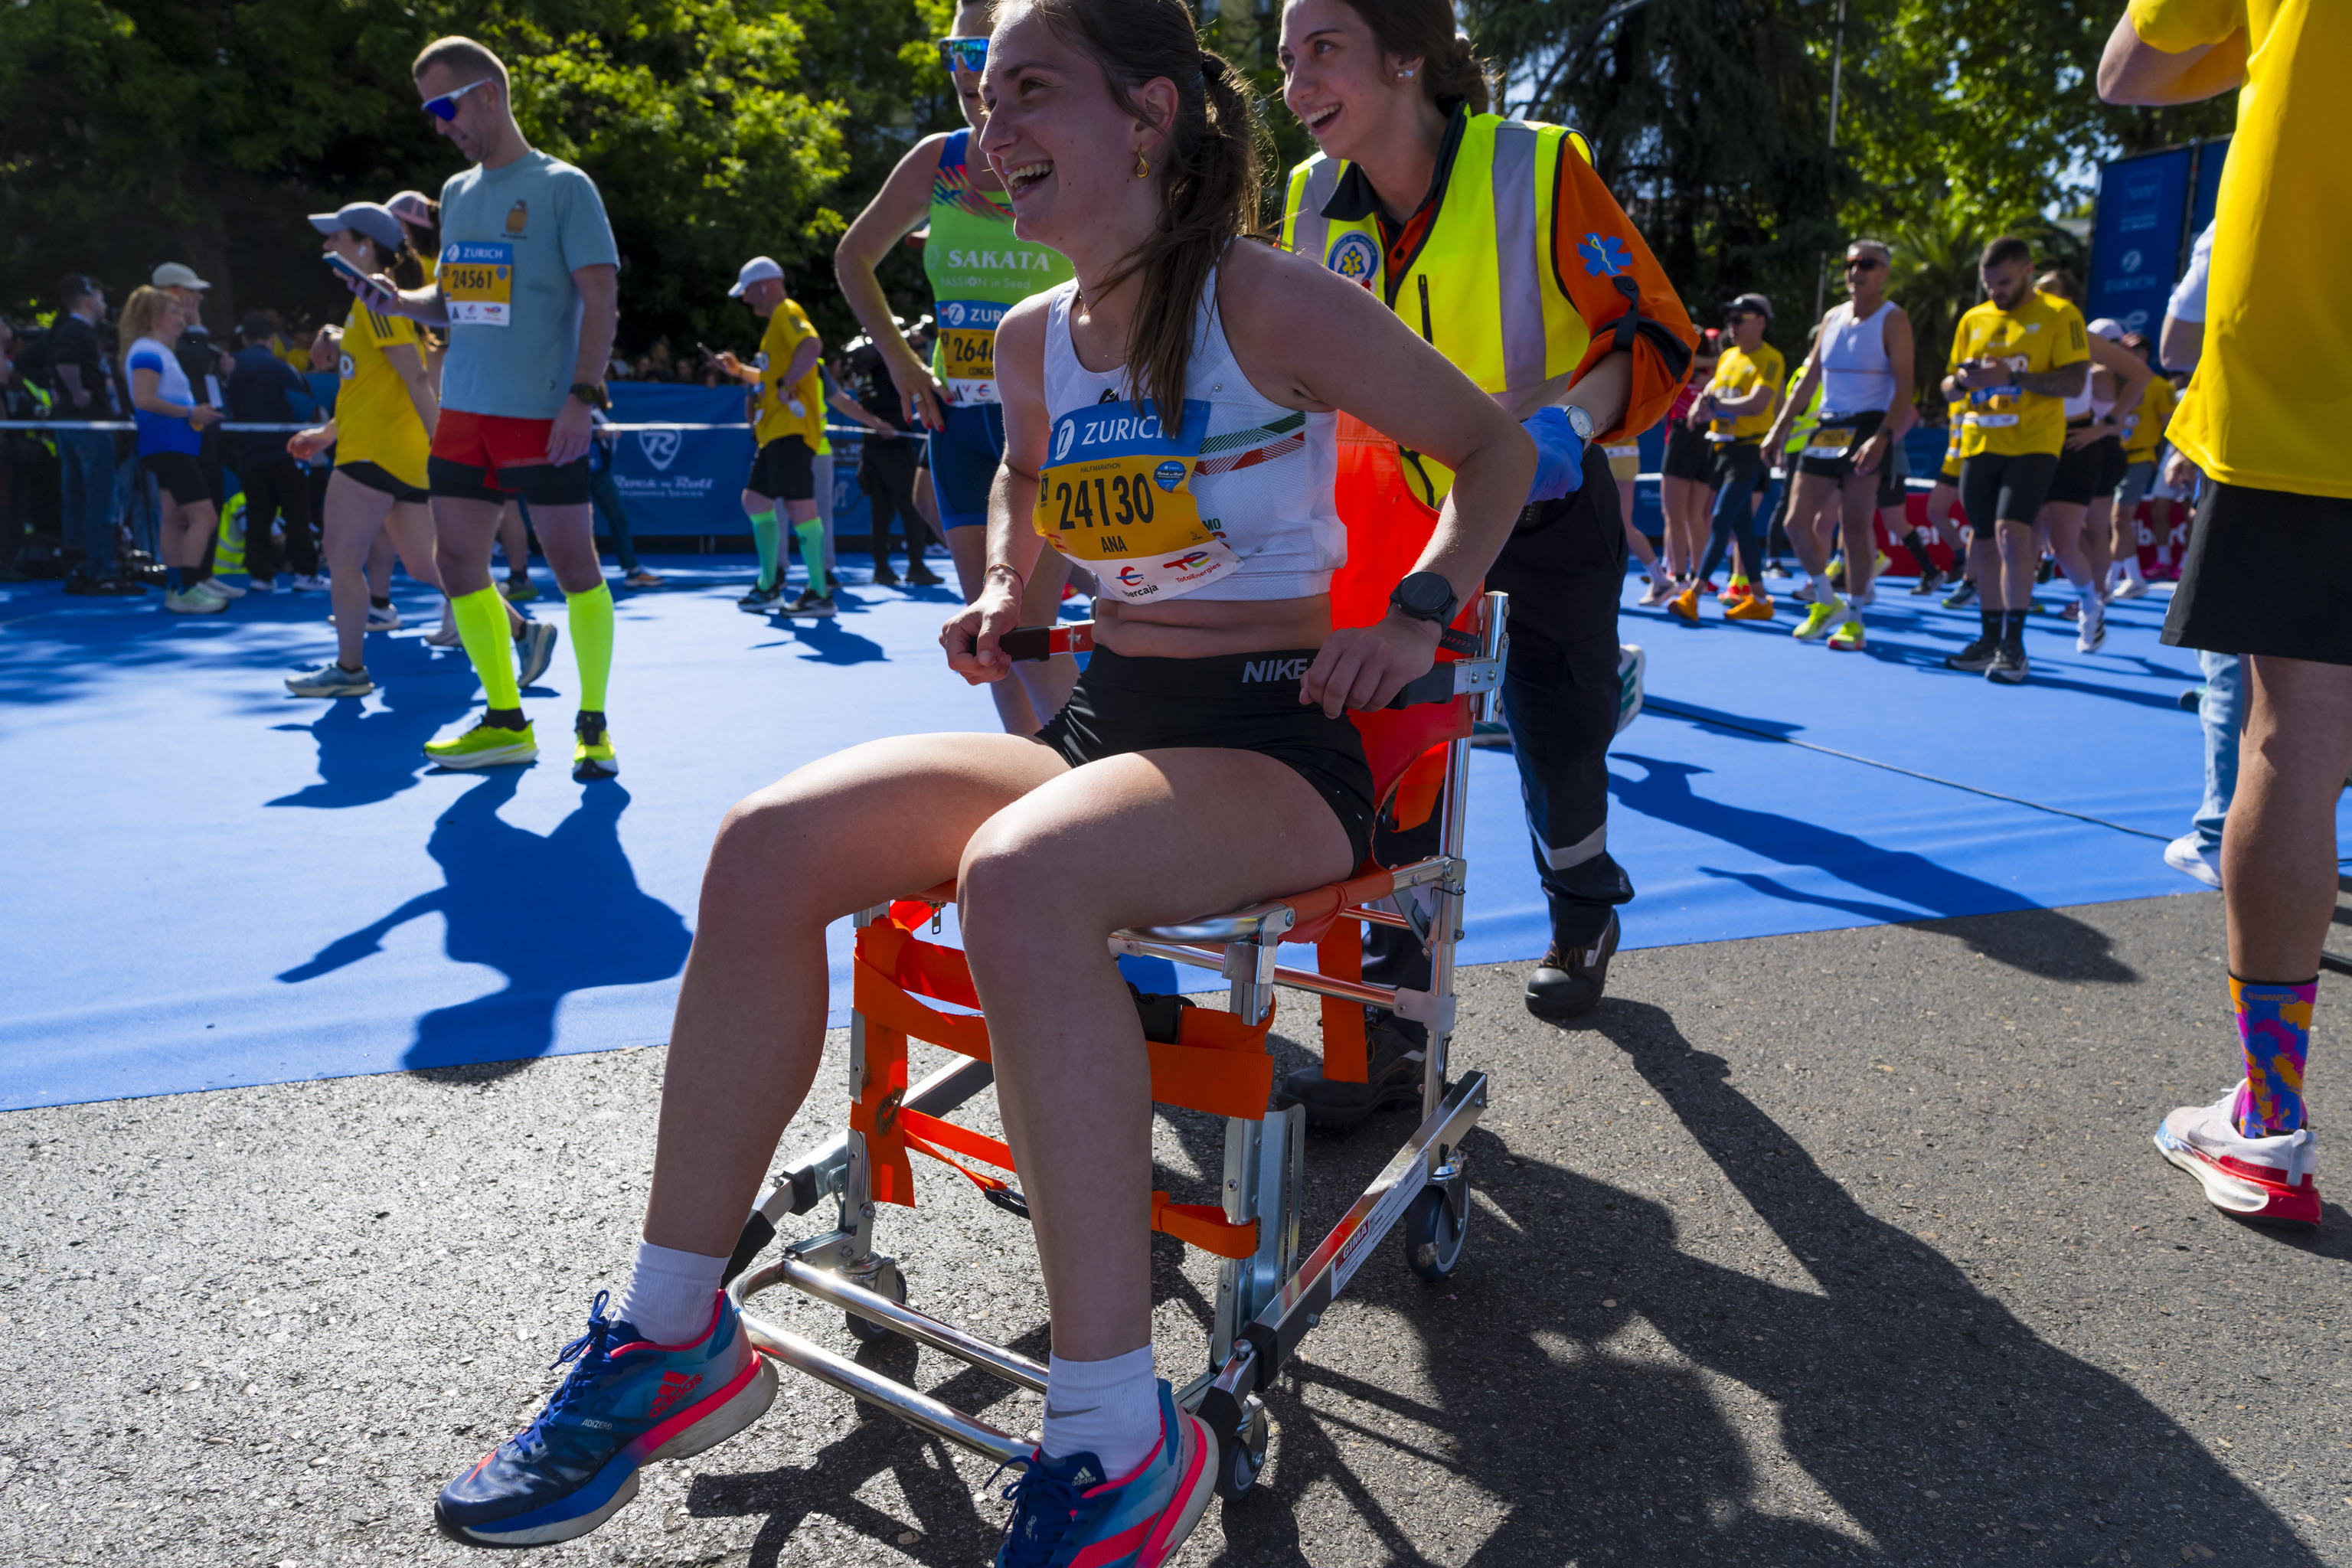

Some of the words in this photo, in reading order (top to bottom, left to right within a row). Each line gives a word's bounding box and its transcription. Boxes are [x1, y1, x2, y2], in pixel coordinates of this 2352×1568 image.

[462, 247, 504, 260] ZURICH
[947, 249, 1051, 273] SAKATA
[452, 268, 492, 289] 24561
[939, 276, 988, 288] PASSION
[990, 276, 1001, 289] in
[1002, 277, 1031, 290] Seed
[1080, 466, 1093, 474] HALF
[1093, 462, 1121, 472] MARATHON
[1055, 472, 1155, 531] 24130
[1100, 535, 1129, 554] ANA
[1175, 562, 1221, 583] TotalEnergies
[1242, 658, 1308, 684] NIKE
[1342, 1224, 1368, 1259] GIMA
[648, 1373, 704, 1419] adidas
[581, 1418, 613, 1431] ADIZERO
[1071, 1475, 1097, 1487] adidas
